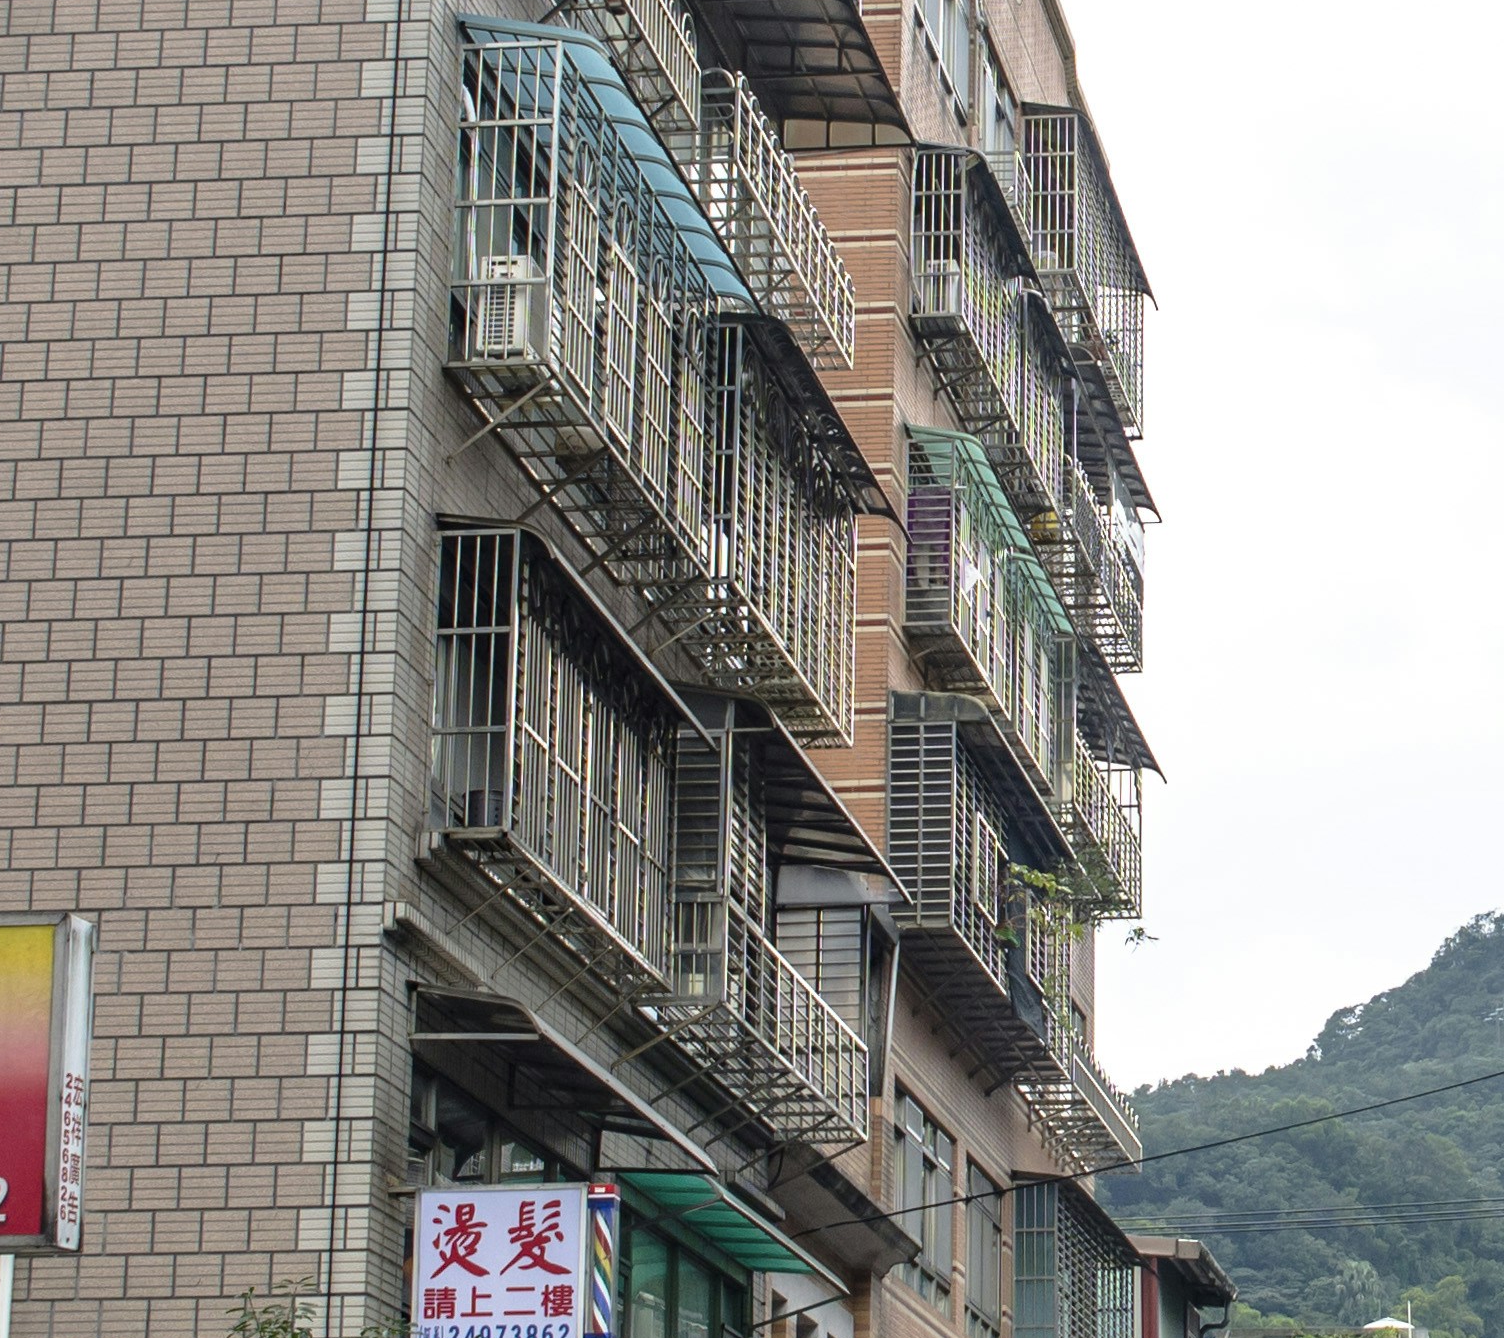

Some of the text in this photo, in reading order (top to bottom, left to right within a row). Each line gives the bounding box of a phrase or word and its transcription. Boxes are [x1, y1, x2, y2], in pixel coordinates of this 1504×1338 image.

[59, 1072, 73, 1221] 24656826
[430, 1199, 572, 1279] 燙髮
[423, 1284, 574, 1320] 請上二樓
